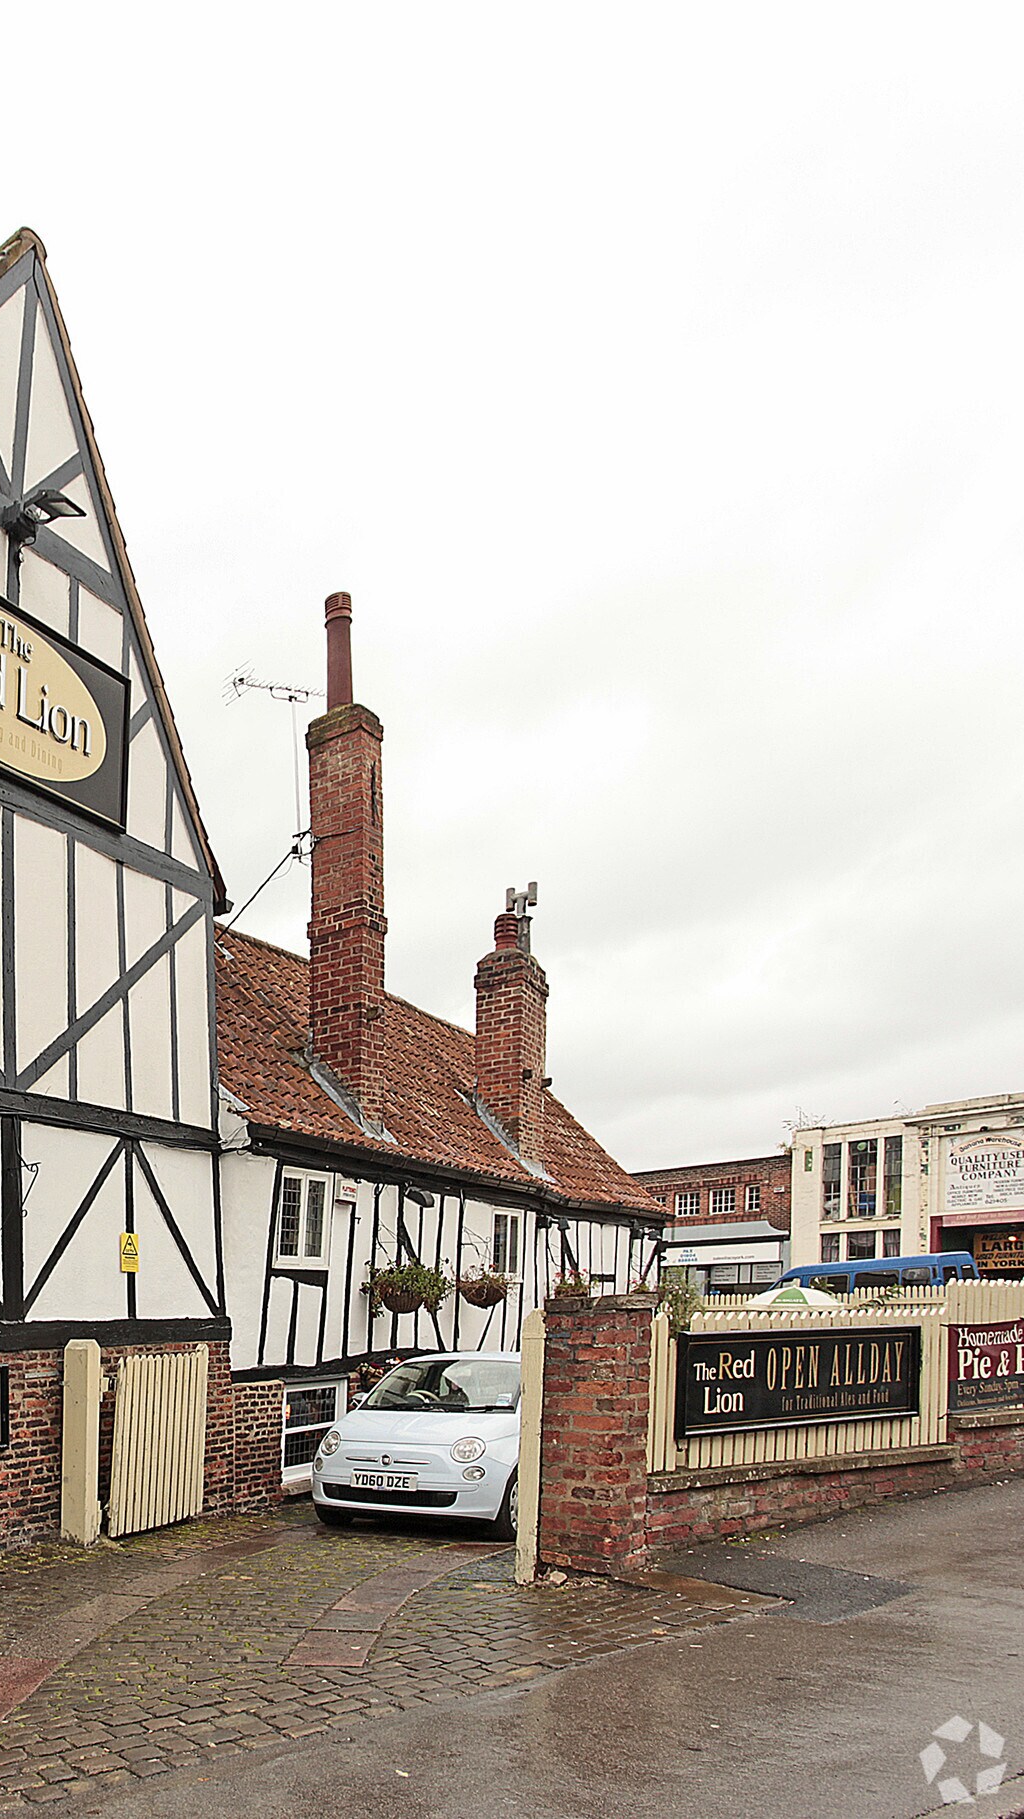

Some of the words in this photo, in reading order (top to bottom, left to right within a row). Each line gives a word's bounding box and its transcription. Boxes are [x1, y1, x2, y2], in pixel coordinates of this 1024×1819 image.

[16, 665, 92, 757] Lion
[8, 732, 26, 752] and
[31, 740, 62, 774] Dining
[951, 1153, 1000, 1165] QUALITY
[1002, 1150, 1024, 1160] USE
[959, 1160, 1021, 1173] FURNITURE
[961, 1170, 1017, 1181] COMPANY
[957, 1324, 1023, 1347] Homemade
[693, 1362, 716, 1381] The
[718, 1349, 755, 1380] Red
[767, 1345, 820, 1390] OPEN
[957, 1347, 992, 1380] Pie
[996, 1350, 1010, 1377] &
[704, 1387, 743, 1414] Lion
[781, 1396, 793, 1411] for
[796, 1392, 837, 1410] Traditional
[841, 1391, 855, 1406] Ales
[858, 1390, 870, 1405] and
[873, 1388, 889, 1403] Food
[958, 1384, 976, 1397] Every
[355, 1474, 384, 1486] YD60
[387, 1476, 410, 1488] DZE
